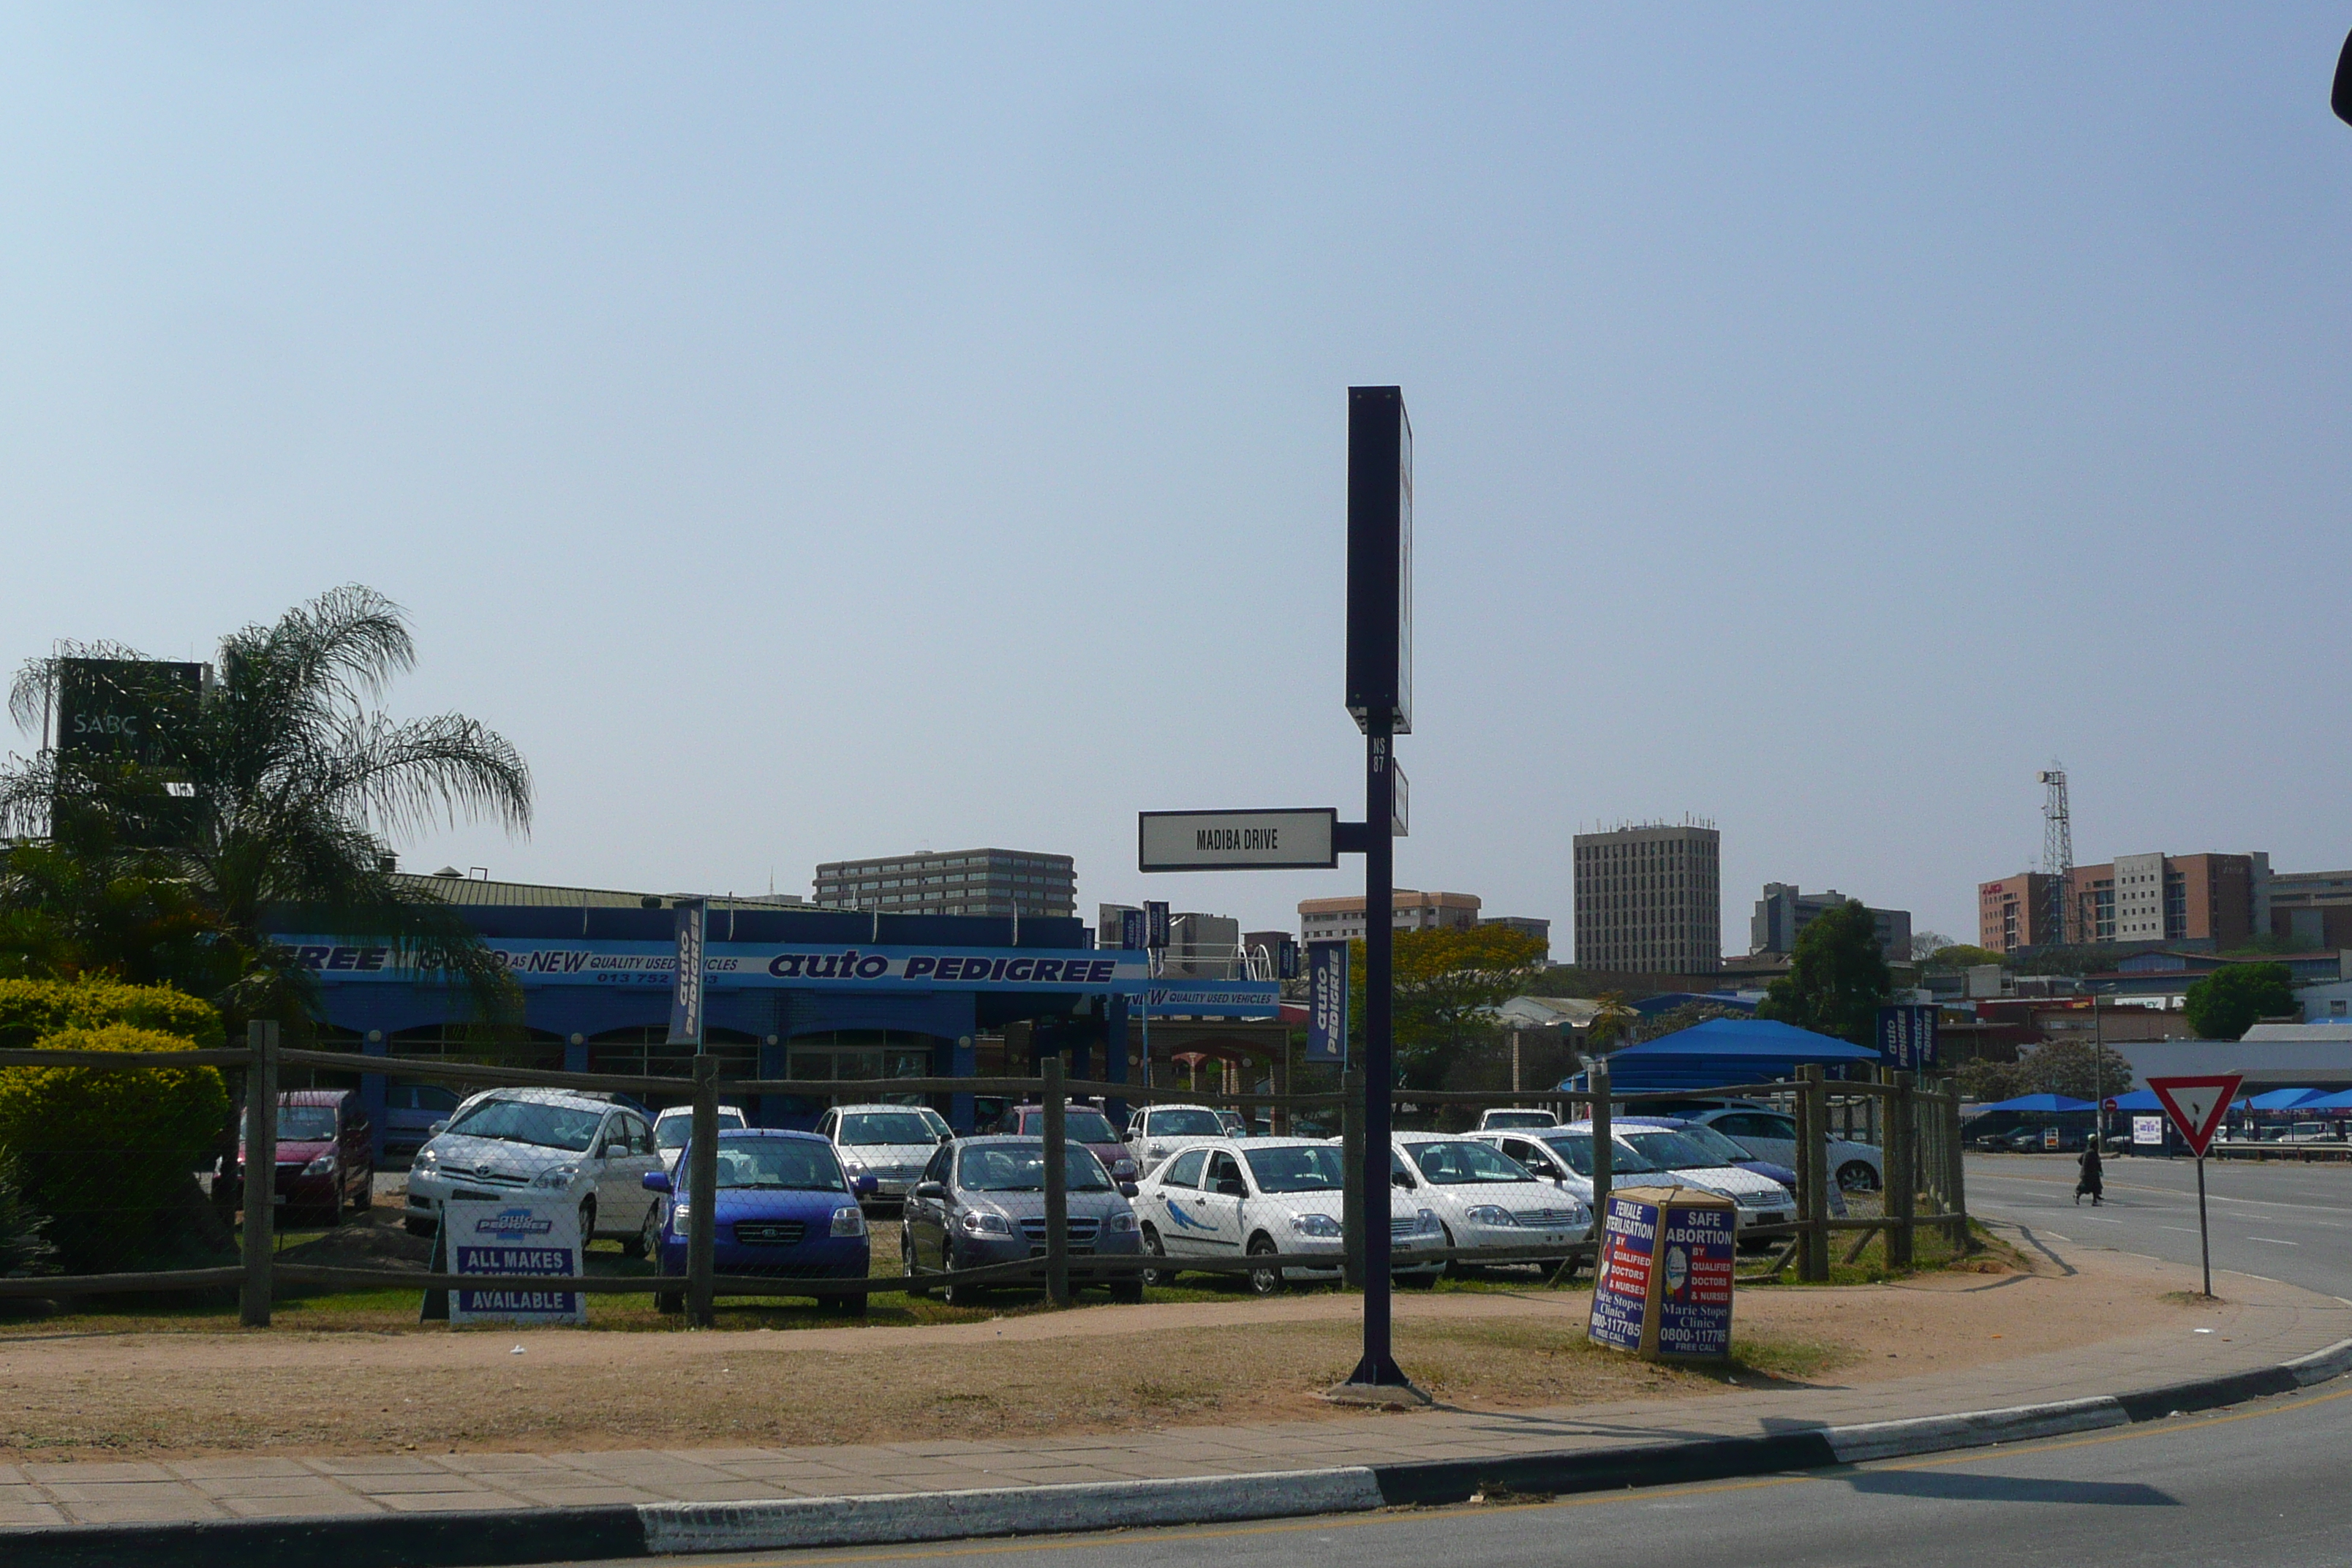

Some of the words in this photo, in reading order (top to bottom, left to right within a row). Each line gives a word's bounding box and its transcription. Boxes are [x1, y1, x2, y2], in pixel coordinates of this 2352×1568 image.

[74, 713, 138, 735] SABC
[1373, 737, 1385, 755] NS
[1373, 755, 1384, 772] 87
[1196, 829, 1240, 851] MADIBA
[1244, 828, 1278, 850] DRIVE
[511, 956, 527, 967] AS
[527, 951, 591, 973] NEW
[590, 957, 643, 970] QUALITY
[646, 958, 675, 970] USED
[680, 930, 689, 1006] auto
[768, 949, 889, 980] auto
[902, 955, 1118, 984] PEDIGREE
[597, 973, 630, 984] 013
[636, 973, 668, 984] 752
[685, 909, 699, 1036] PEDIGREE
[1169, 992, 1206, 1003] QUALITY
[1207, 993, 1229, 1003] USED
[1232, 994, 1272, 1004] VEHICLES
[1317, 966, 1328, 1030] auto
[1327, 949, 1340, 1055] PEDIGREE
[1887, 1019, 1897, 1055] auto
[1897, 1009, 1908, 1068] PEDIGREE
[500, 1214, 534, 1223] auto
[1616, 1201, 1643, 1221] FEMALE
[1689, 1212, 1721, 1227] SAFE
[1606, 1215, 1654, 1240] STERILISATION
[1616, 1237, 1626, 1246] BY
[1666, 1228, 1732, 1245] ABORTION
[467, 1251, 500, 1267] ALL
[504, 1251, 564, 1269] MAKES
[1614, 1251, 1651, 1267] QUALIFIED
[1693, 1248, 1705, 1256] BY
[1612, 1265, 1645, 1281] DOCTORS
[1692, 1262, 1731, 1272] QUALIFIED
[1610, 1280, 1615, 1288] &
[1616, 1281, 1646, 1296] NURSES
[1692, 1277, 1727, 1286] DOCTORS
[472, 1291, 564, 1309] AVAILABLE
[1597, 1289, 1613, 1303] Marie
[1613, 1294, 1644, 1311] Stopes
[1692, 1292, 1697, 1300] &
[1700, 1292, 1728, 1301] NURSES
[1601, 1303, 1627, 1319] Clinics
[1662, 1303, 1698, 1316] Marie
[1700, 1305, 1727, 1319] Stopes
[1592, 1312, 1641, 1338] 0800-117785
[1680, 1316, 1716, 1329] Clinics
[1597, 1328, 1609, 1339] FREE
[1610, 1332, 1626, 1343] CALL
[1660, 1327, 1726, 1343] 0800-117785
[1676, 1343, 1697, 1352] FREE
